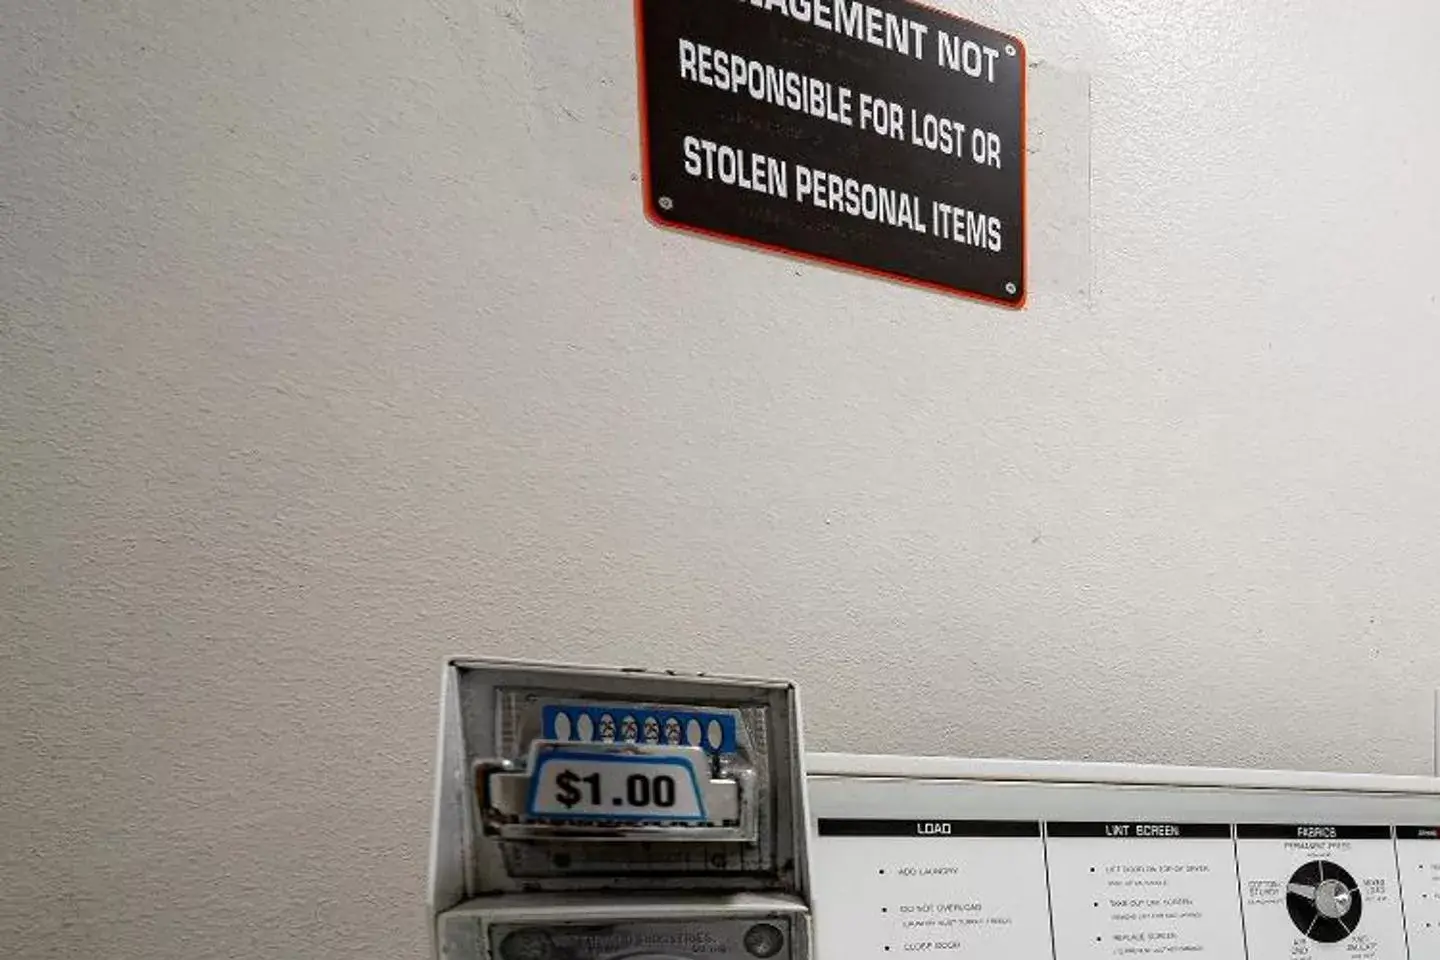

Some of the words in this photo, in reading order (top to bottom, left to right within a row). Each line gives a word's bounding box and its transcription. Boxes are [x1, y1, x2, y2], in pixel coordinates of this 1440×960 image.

[938, 31, 999, 83] NOT
[679, 38, 852, 126] RESPONSIBLE
[860, 94, 904, 140] FOR
[911, 108, 966, 157] LOST
[971, 129, 1001, 169] OR
[683, 135, 788, 199] STOLEN
[795, 164, 926, 234] PERSONAL
[933, 202, 1002, 252] ITEMS
[555, 769, 675, 809] $1.00
[917, 822, 951, 835] LOAD
[1105, 825, 1130, 836] LINT
[1136, 825, 1180, 836] SCREEN
[1297, 827, 1337, 838] FABRICS
